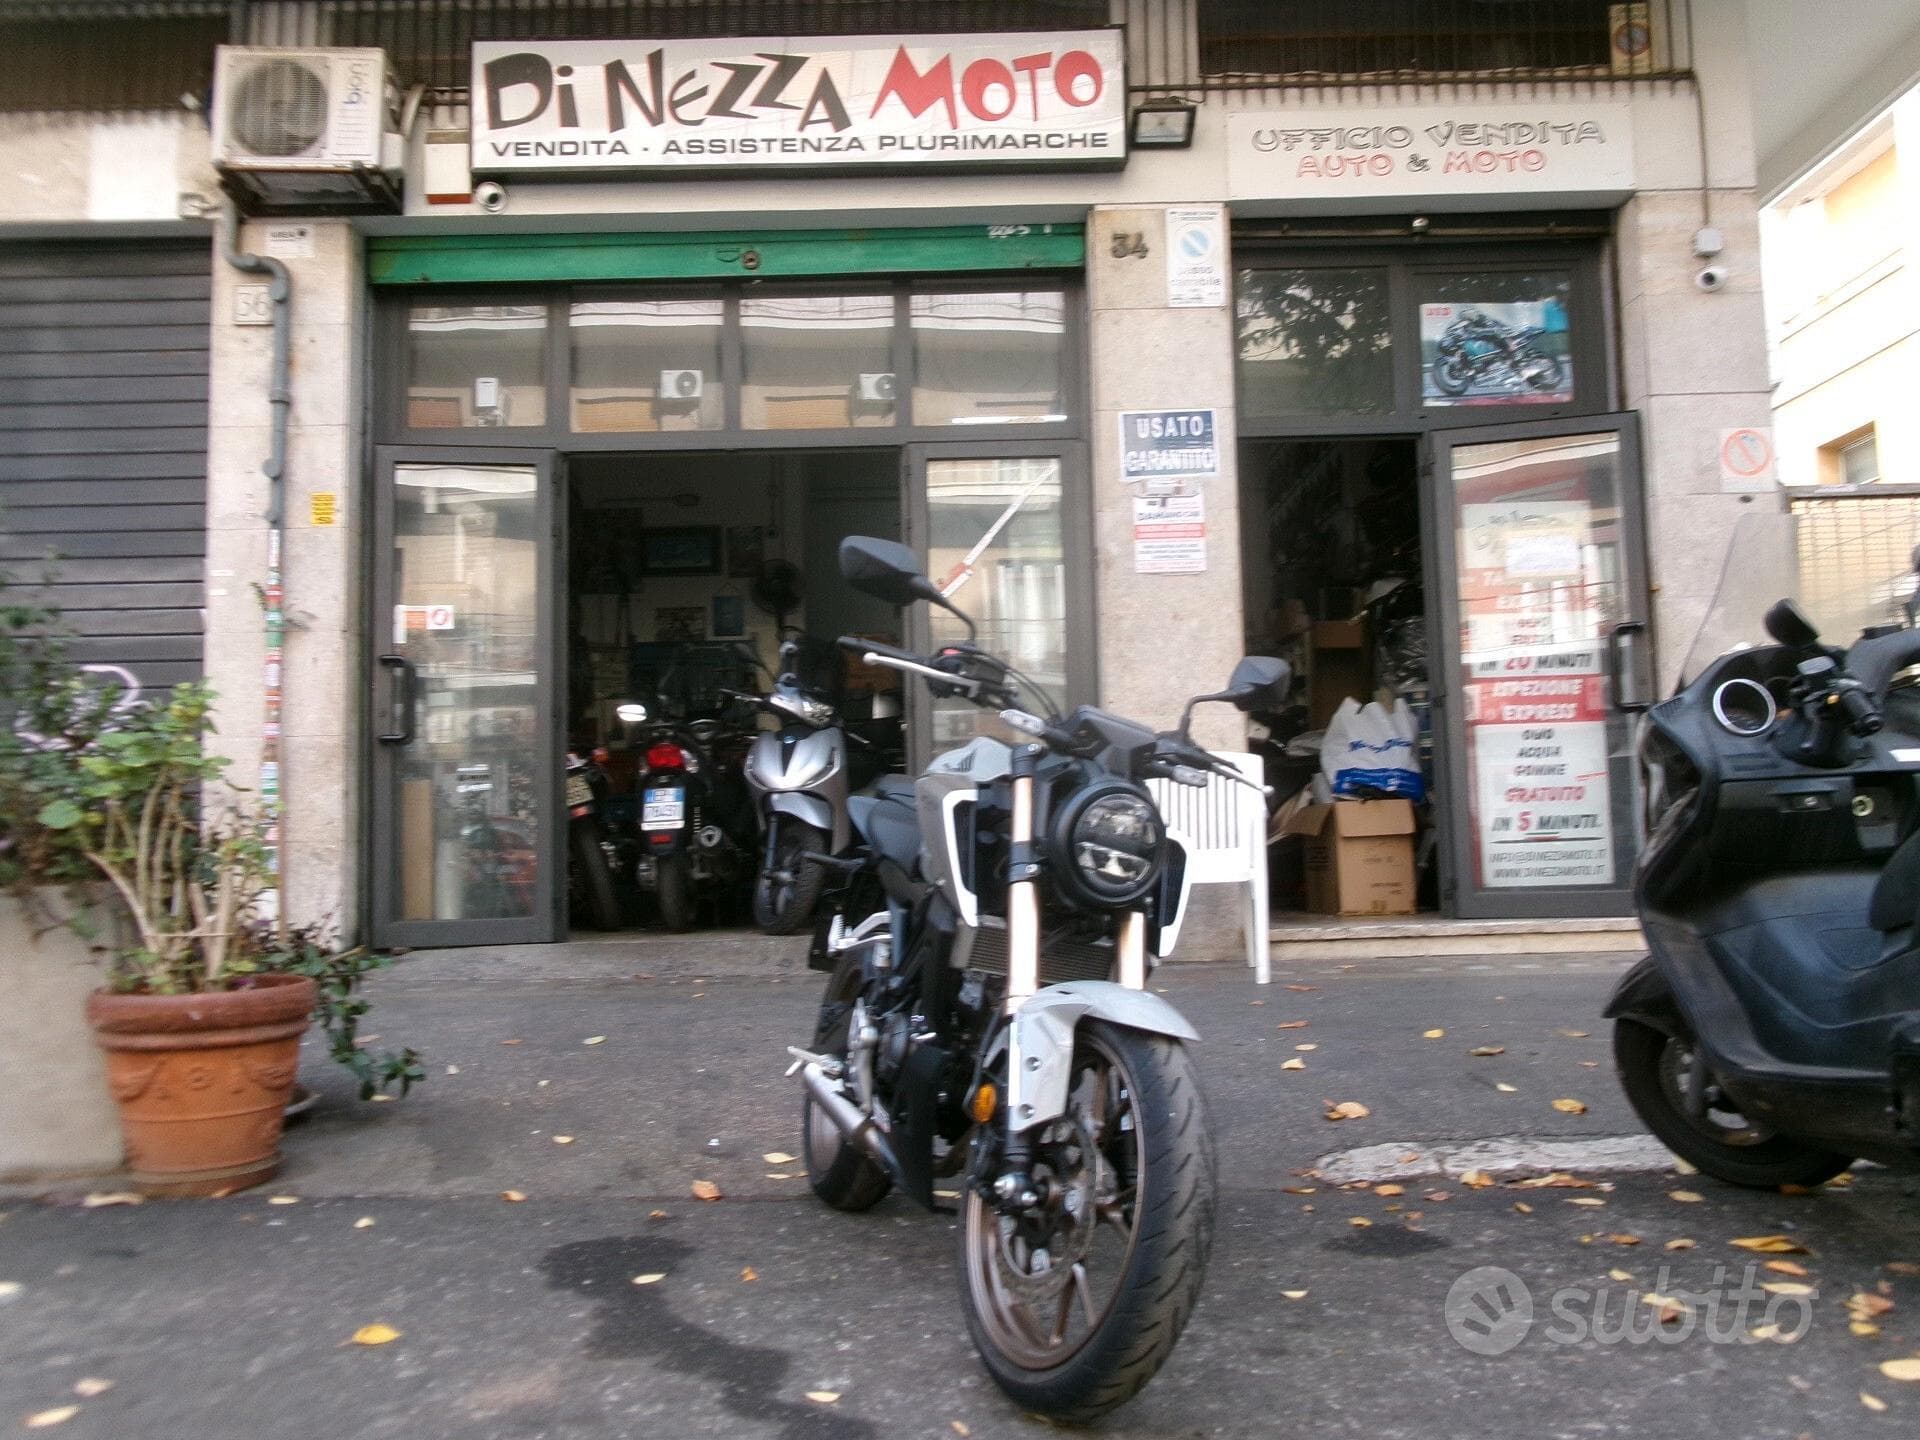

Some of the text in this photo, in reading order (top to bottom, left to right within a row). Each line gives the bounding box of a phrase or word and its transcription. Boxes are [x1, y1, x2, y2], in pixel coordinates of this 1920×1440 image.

[482, 51, 580, 131] Di
[868, 43, 1104, 130] MOTO
[491, 139, 629, 158] VENDITA
[663, 135, 866, 155] ASSISTENZA
[879, 130, 1109, 151] PLURIMARCHE
[1251, 119, 1605, 153] UFFICIO VENDITA
[1296, 149, 1545, 179] AUTO & MOTO
[1110, 231, 1149, 259] 34
[1135, 416, 1205, 438] USATO
[1504, 656, 1532, 671] 20
[1516, 746, 1563, 759] ACQUA
[1505, 786, 1586, 804] GRATUITO
[1517, 811, 1532, 832] 5
